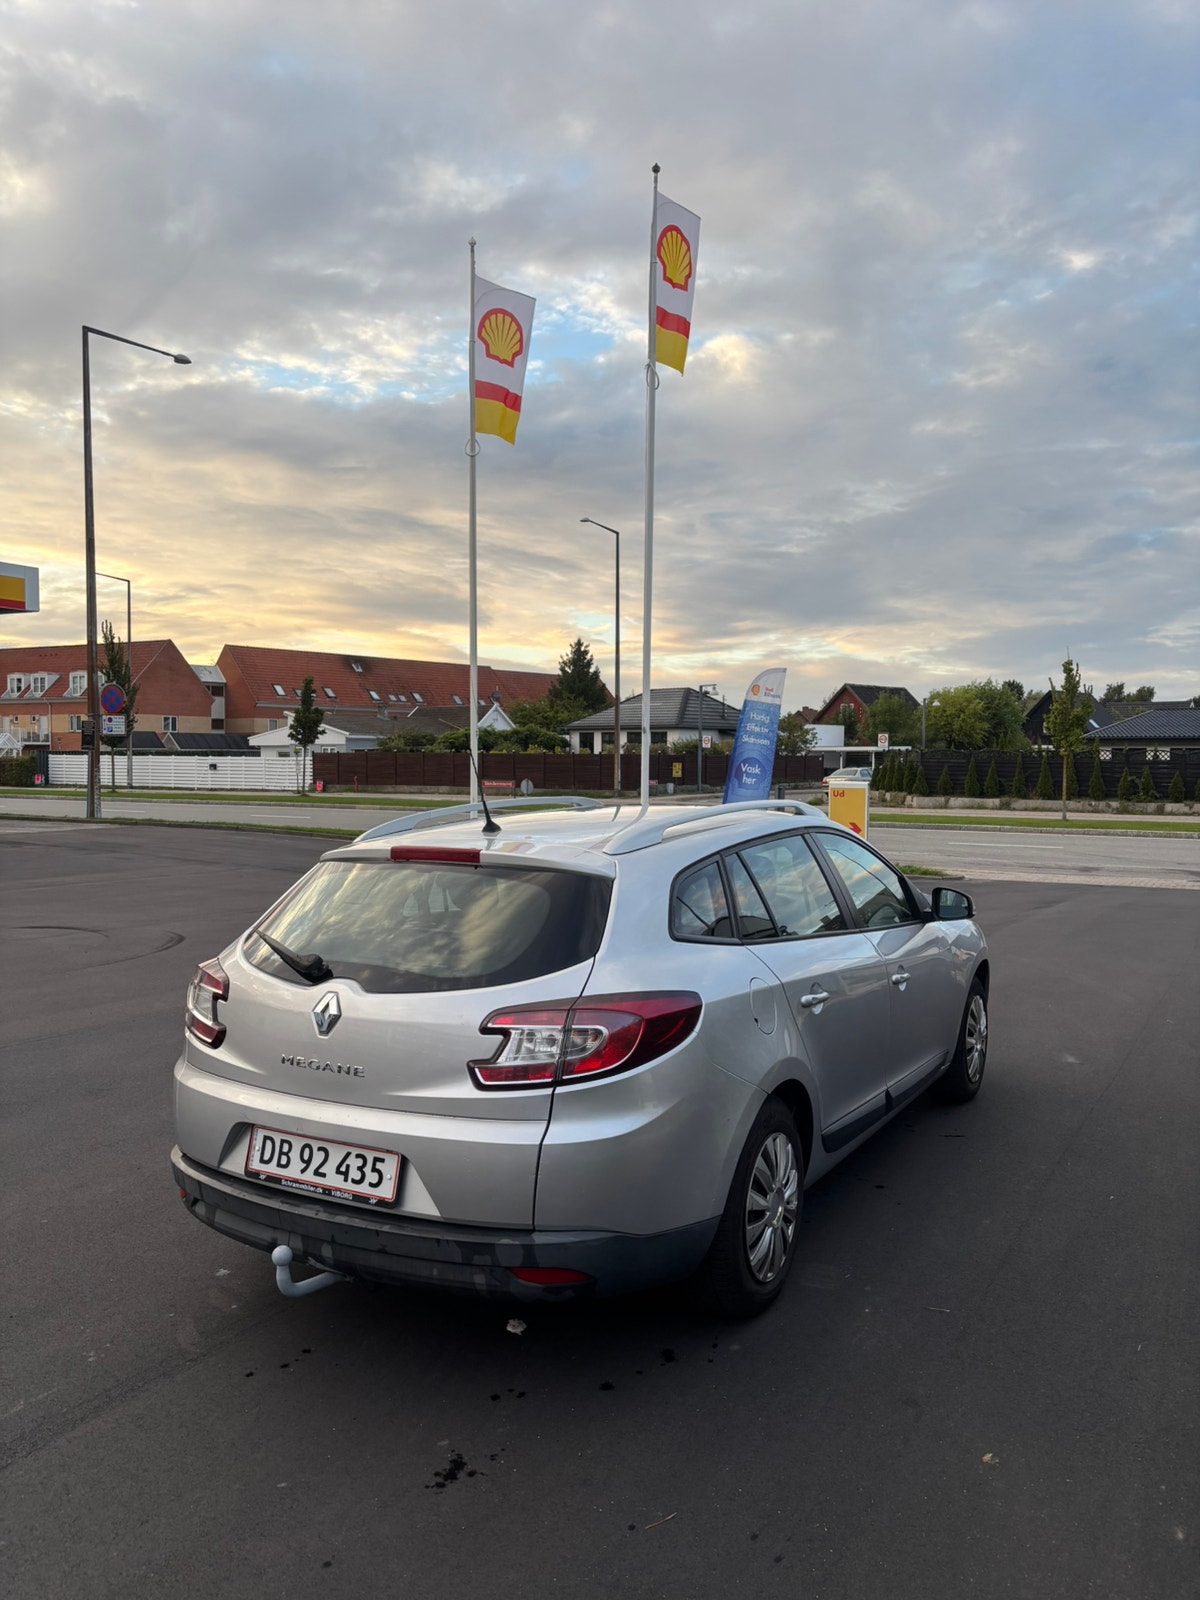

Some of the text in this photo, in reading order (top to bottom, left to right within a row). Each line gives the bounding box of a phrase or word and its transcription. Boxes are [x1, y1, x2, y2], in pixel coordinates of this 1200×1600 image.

[750, 711, 770, 723] Hurtig
[746, 722, 769, 734] Effektiv
[740, 762, 761, 775] Vask
[742, 773, 757, 785] her
[832, 789, 845, 798] Ud
[281, 1053, 365, 1078] MEGANE
[259, 1135, 386, 1189] DB 92 435
[331, 1189, 353, 1200] VIBORG
